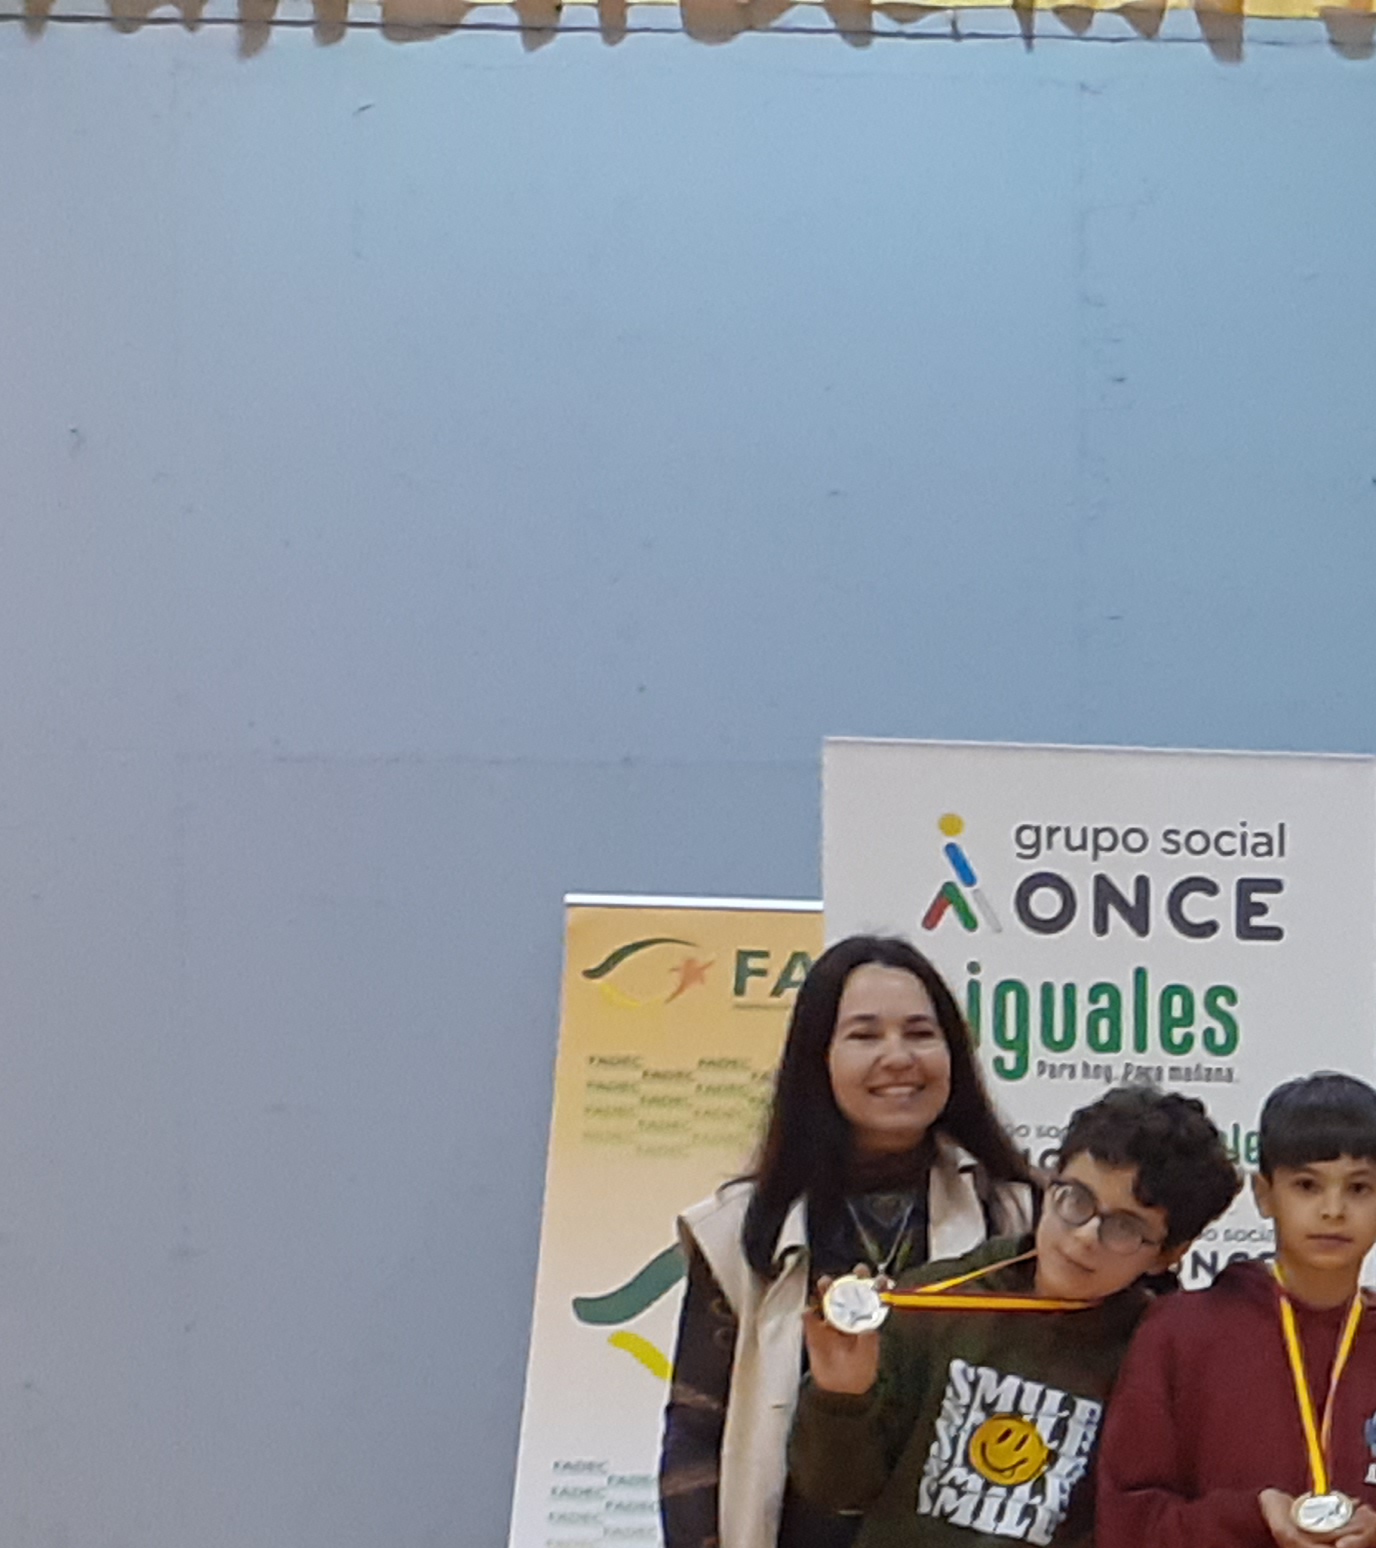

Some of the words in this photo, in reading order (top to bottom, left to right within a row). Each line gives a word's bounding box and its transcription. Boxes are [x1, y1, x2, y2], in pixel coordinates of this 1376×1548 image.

[1014, 823, 1149, 861] grupo
[1161, 821, 1286, 857] social
[1014, 871, 1285, 941] ONCE
[966, 961, 1239, 1081] iguales
